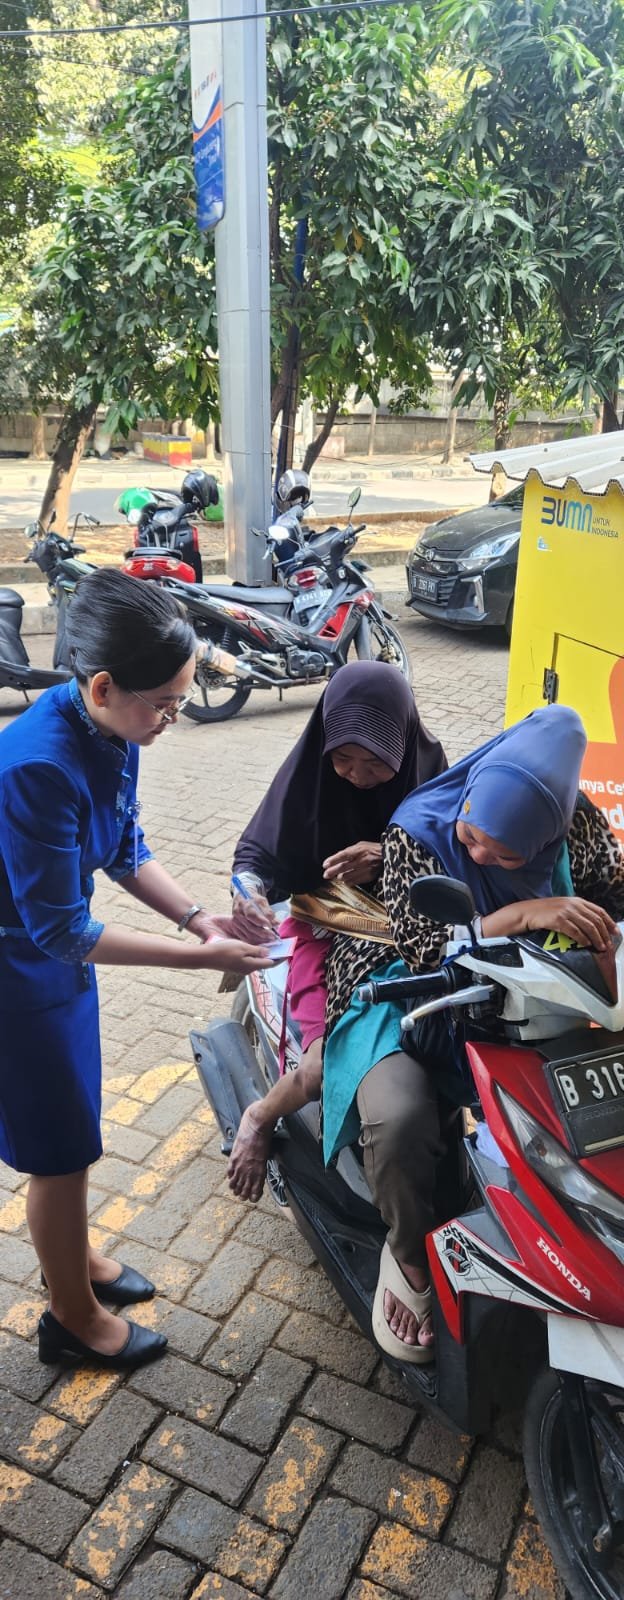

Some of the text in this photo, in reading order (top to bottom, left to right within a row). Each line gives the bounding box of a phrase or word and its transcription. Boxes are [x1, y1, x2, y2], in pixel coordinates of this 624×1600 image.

[592, 517, 610, 526] UNTUK
[591, 527, 619, 538] INDONESIA
[559, 1075, 579, 1106] B
[536, 1236, 591, 1301] HONDA
